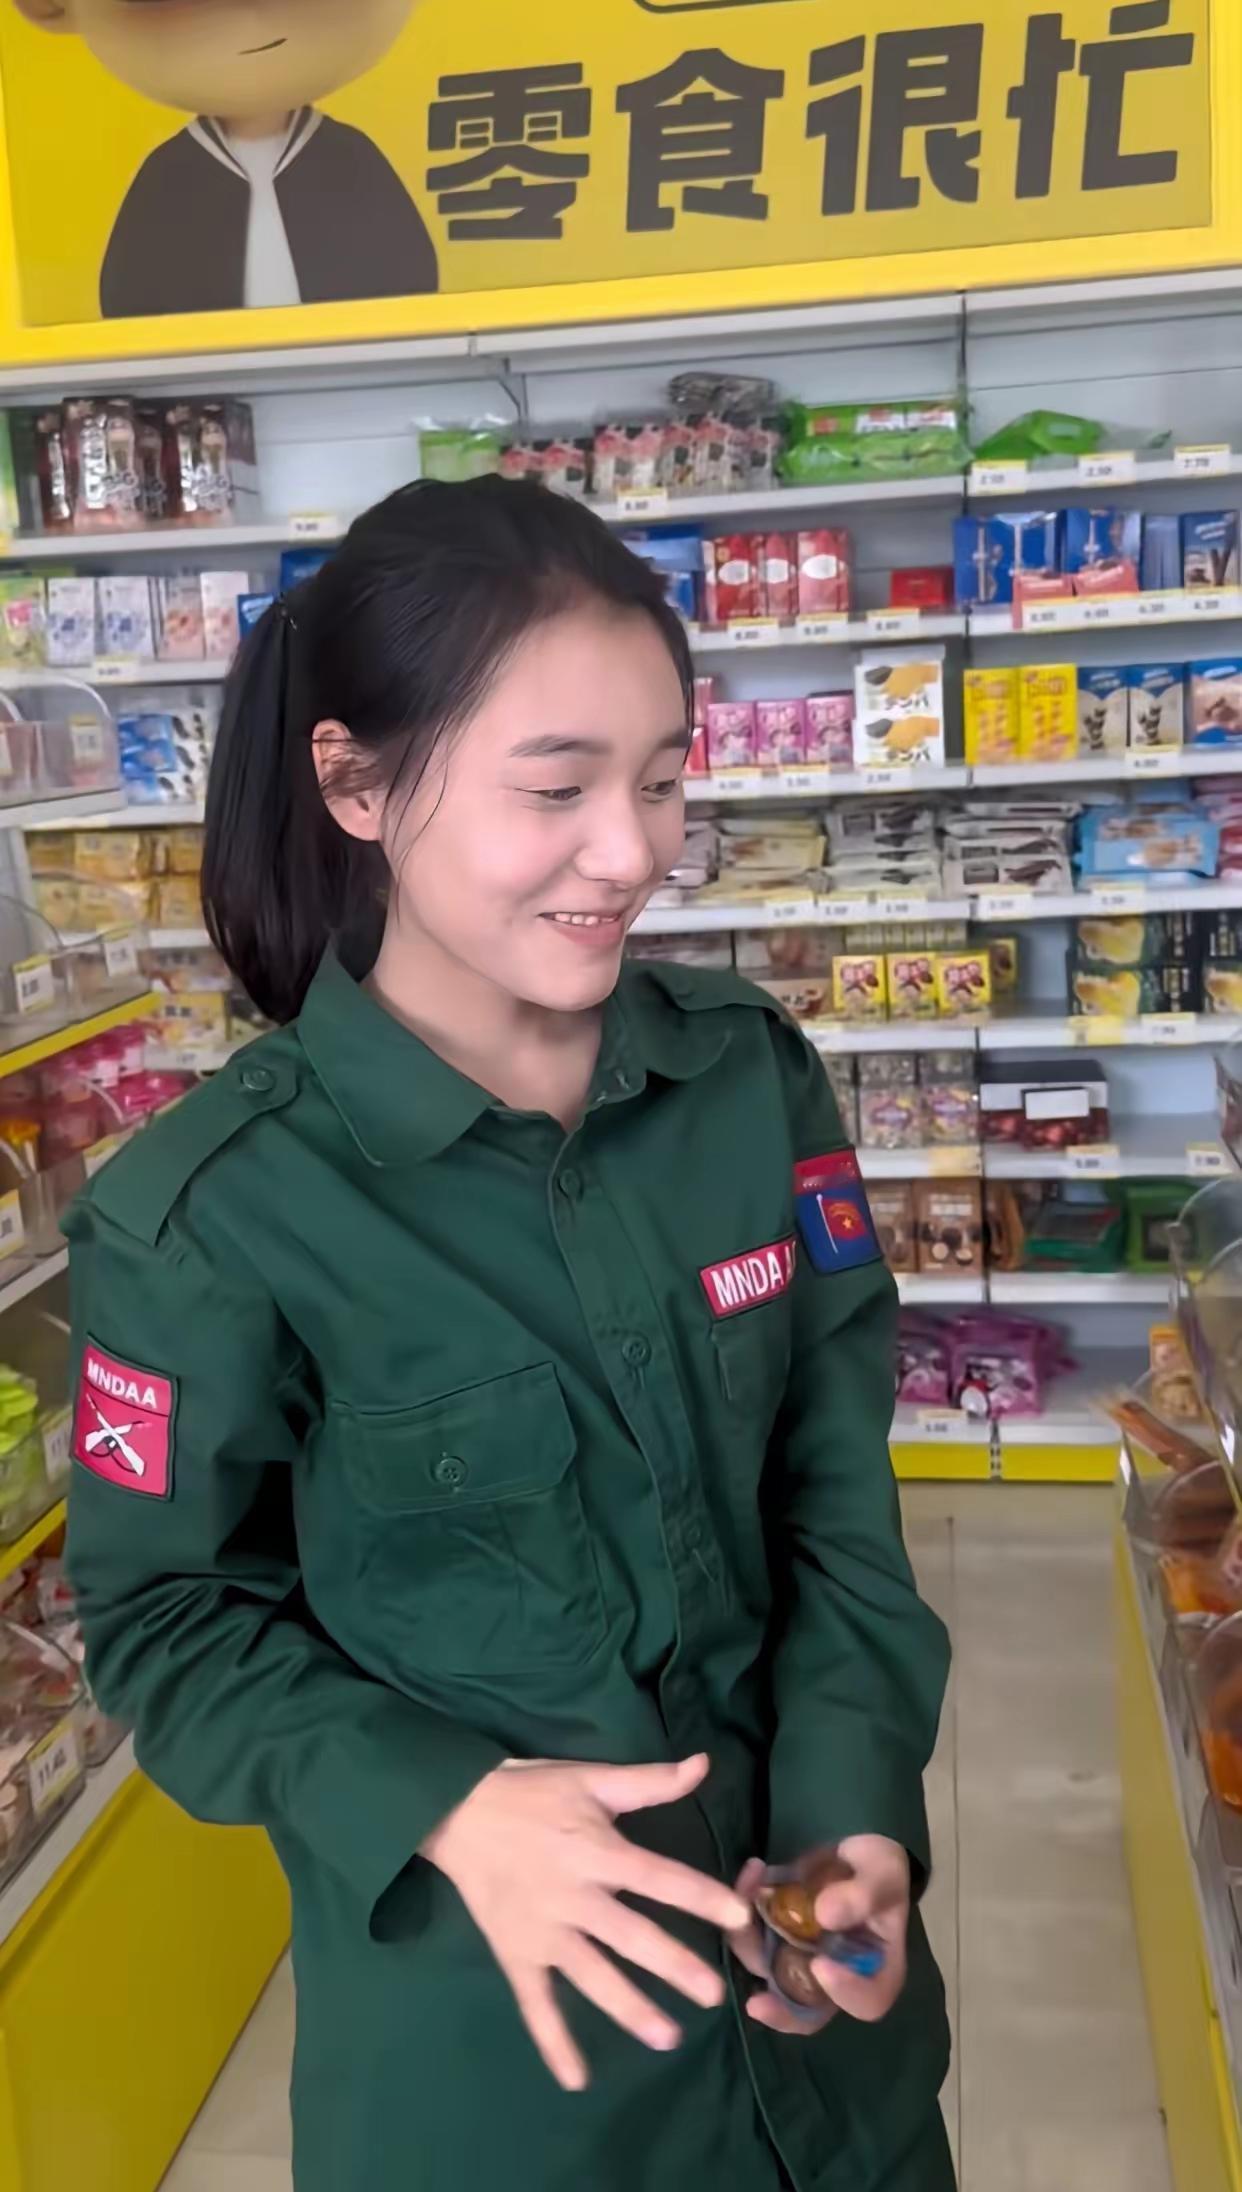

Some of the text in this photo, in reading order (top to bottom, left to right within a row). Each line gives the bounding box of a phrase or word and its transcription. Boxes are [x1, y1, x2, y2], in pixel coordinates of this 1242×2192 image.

[426, 0, 1195, 240] 零食很忙
[87, 1357, 158, 1409] MNDAA
